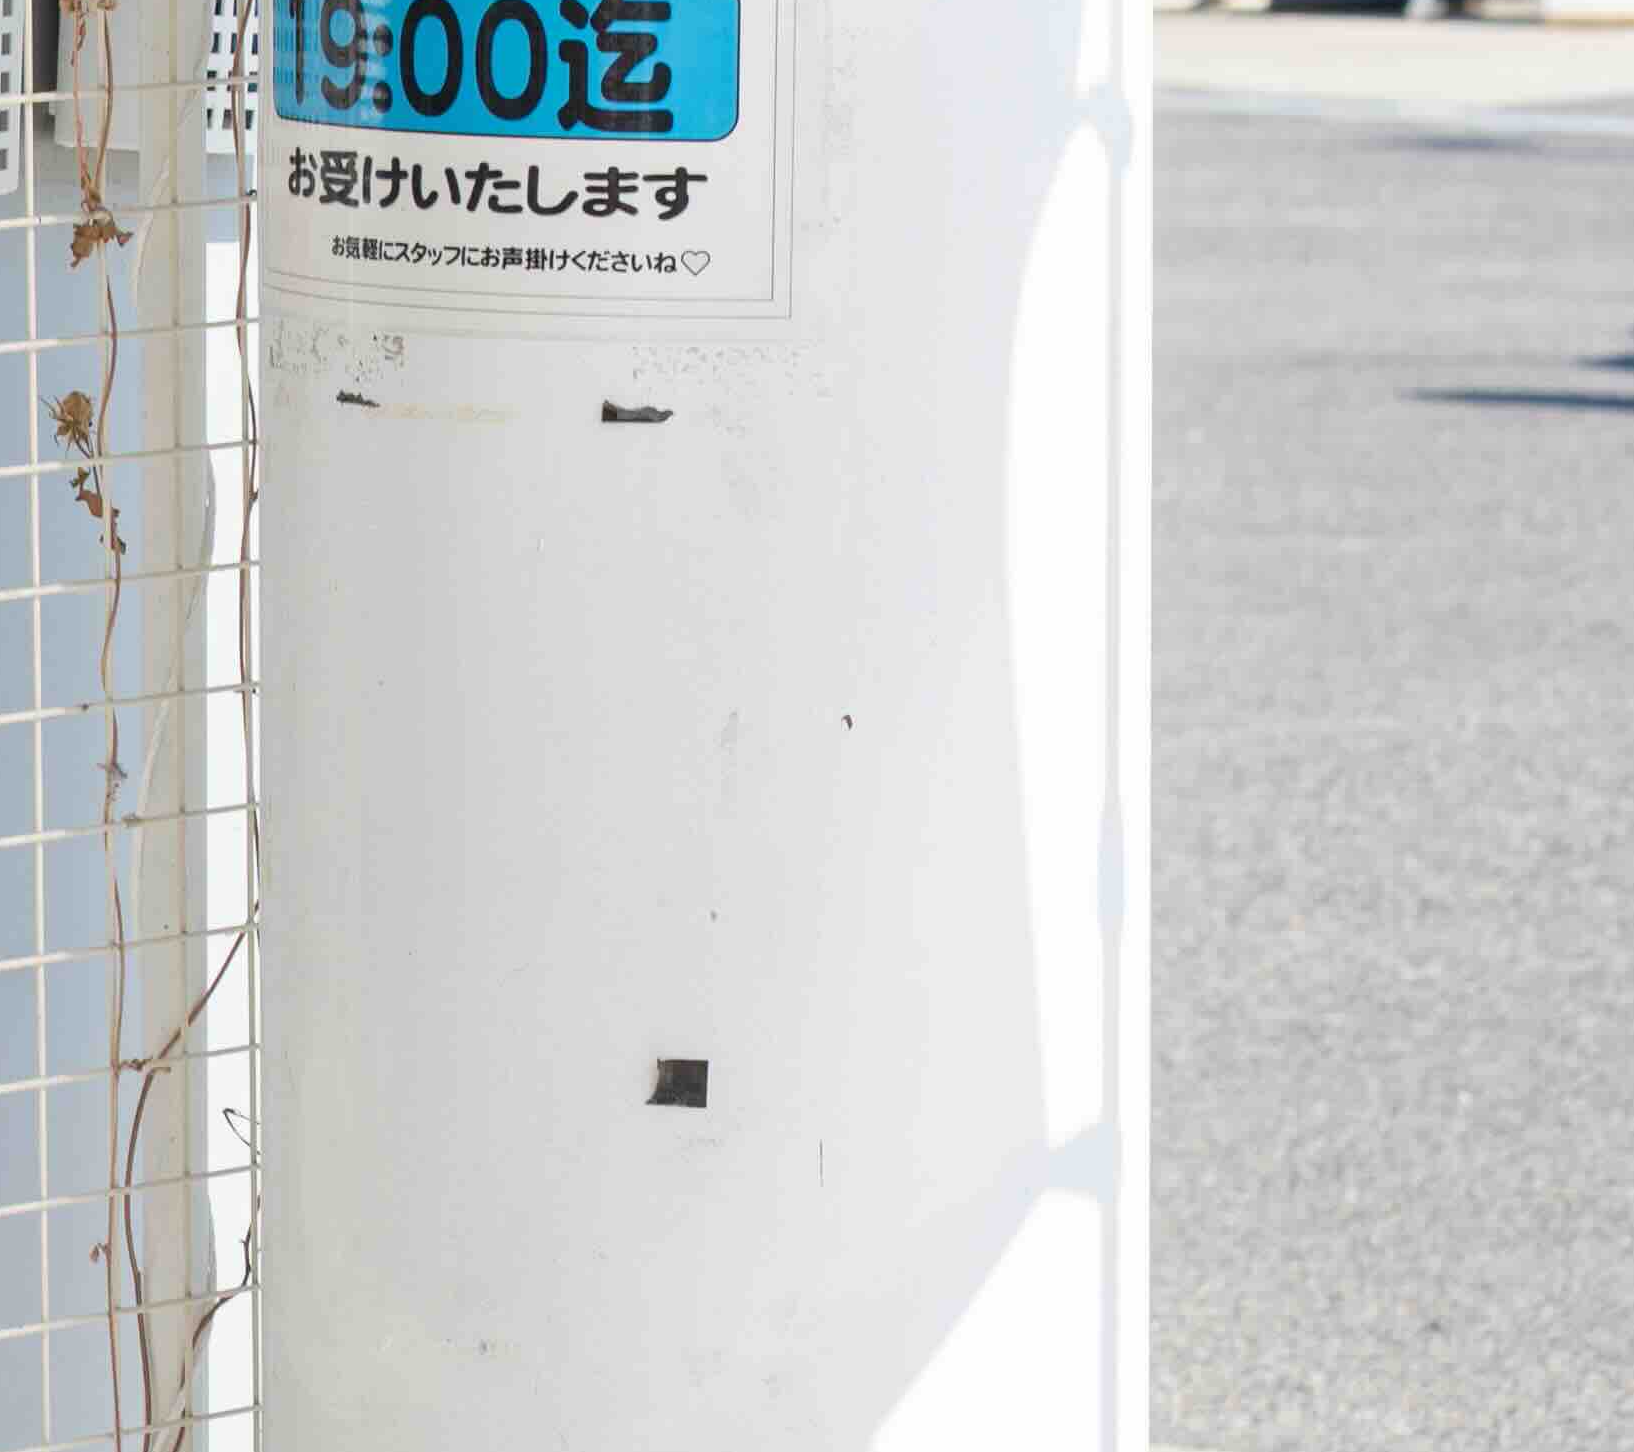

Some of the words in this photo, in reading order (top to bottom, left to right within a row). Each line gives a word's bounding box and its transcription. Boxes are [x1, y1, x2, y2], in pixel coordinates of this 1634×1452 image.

[286, 146, 709, 222] お受けいたします
[330, 233, 678, 276] お気軽にスタッフにお声掛けくださいね
